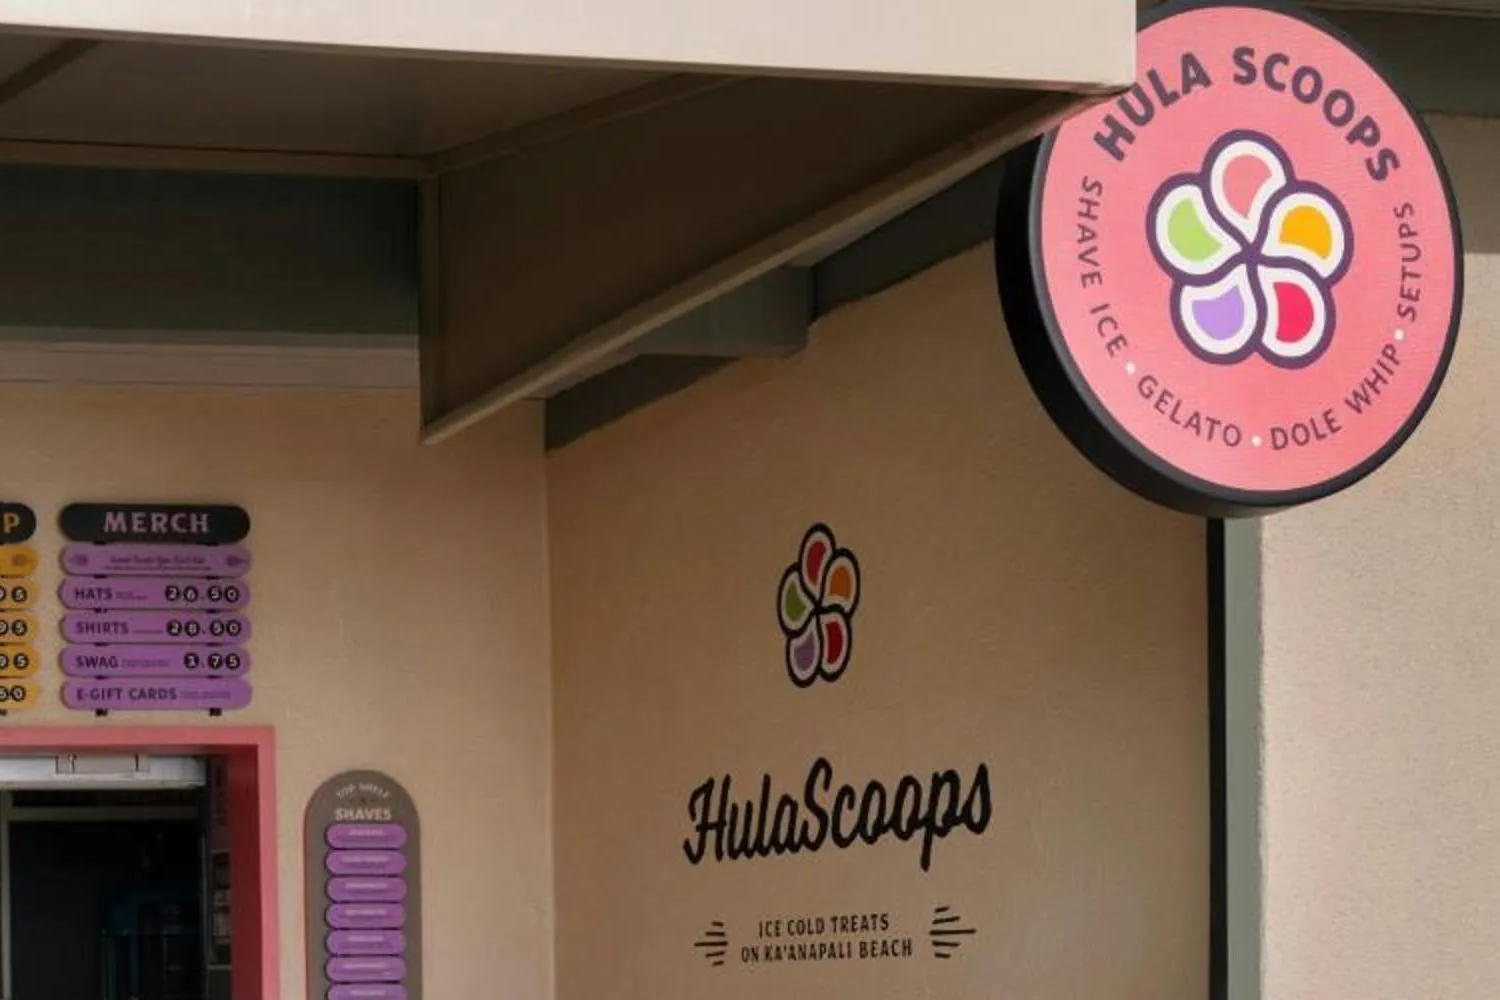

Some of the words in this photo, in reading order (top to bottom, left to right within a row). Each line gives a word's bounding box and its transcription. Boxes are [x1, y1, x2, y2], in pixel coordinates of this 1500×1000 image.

[1093, 52, 1212, 162] HULA
[1232, 46, 1400, 182] SCOOPS
[1077, 176, 1103, 288] SHAVE
[1090, 303, 1128, 359] ICE
[1137, 375, 1242, 447] GELATO
[1271, 410, 1342, 451] DOLE
[1346, 343, 1401, 414] WHIP
[1398, 202, 1422, 322] SETUPS
[104, 511, 210, 533] MERCH
[75, 587, 113, 602] HATS
[75, 621, 129, 635] SHIRTS
[75, 655, 119, 669] SWAG
[128, 687, 178, 701] CARDS
[334, 806, 393, 821] SHAVES
[758, 920, 781, 939] ICE
[787, 917, 825, 937] COLD
[830, 913, 890, 933] TREATS
[741, 945, 759, 963] ON
[859, 938, 913, 959] BEACH
